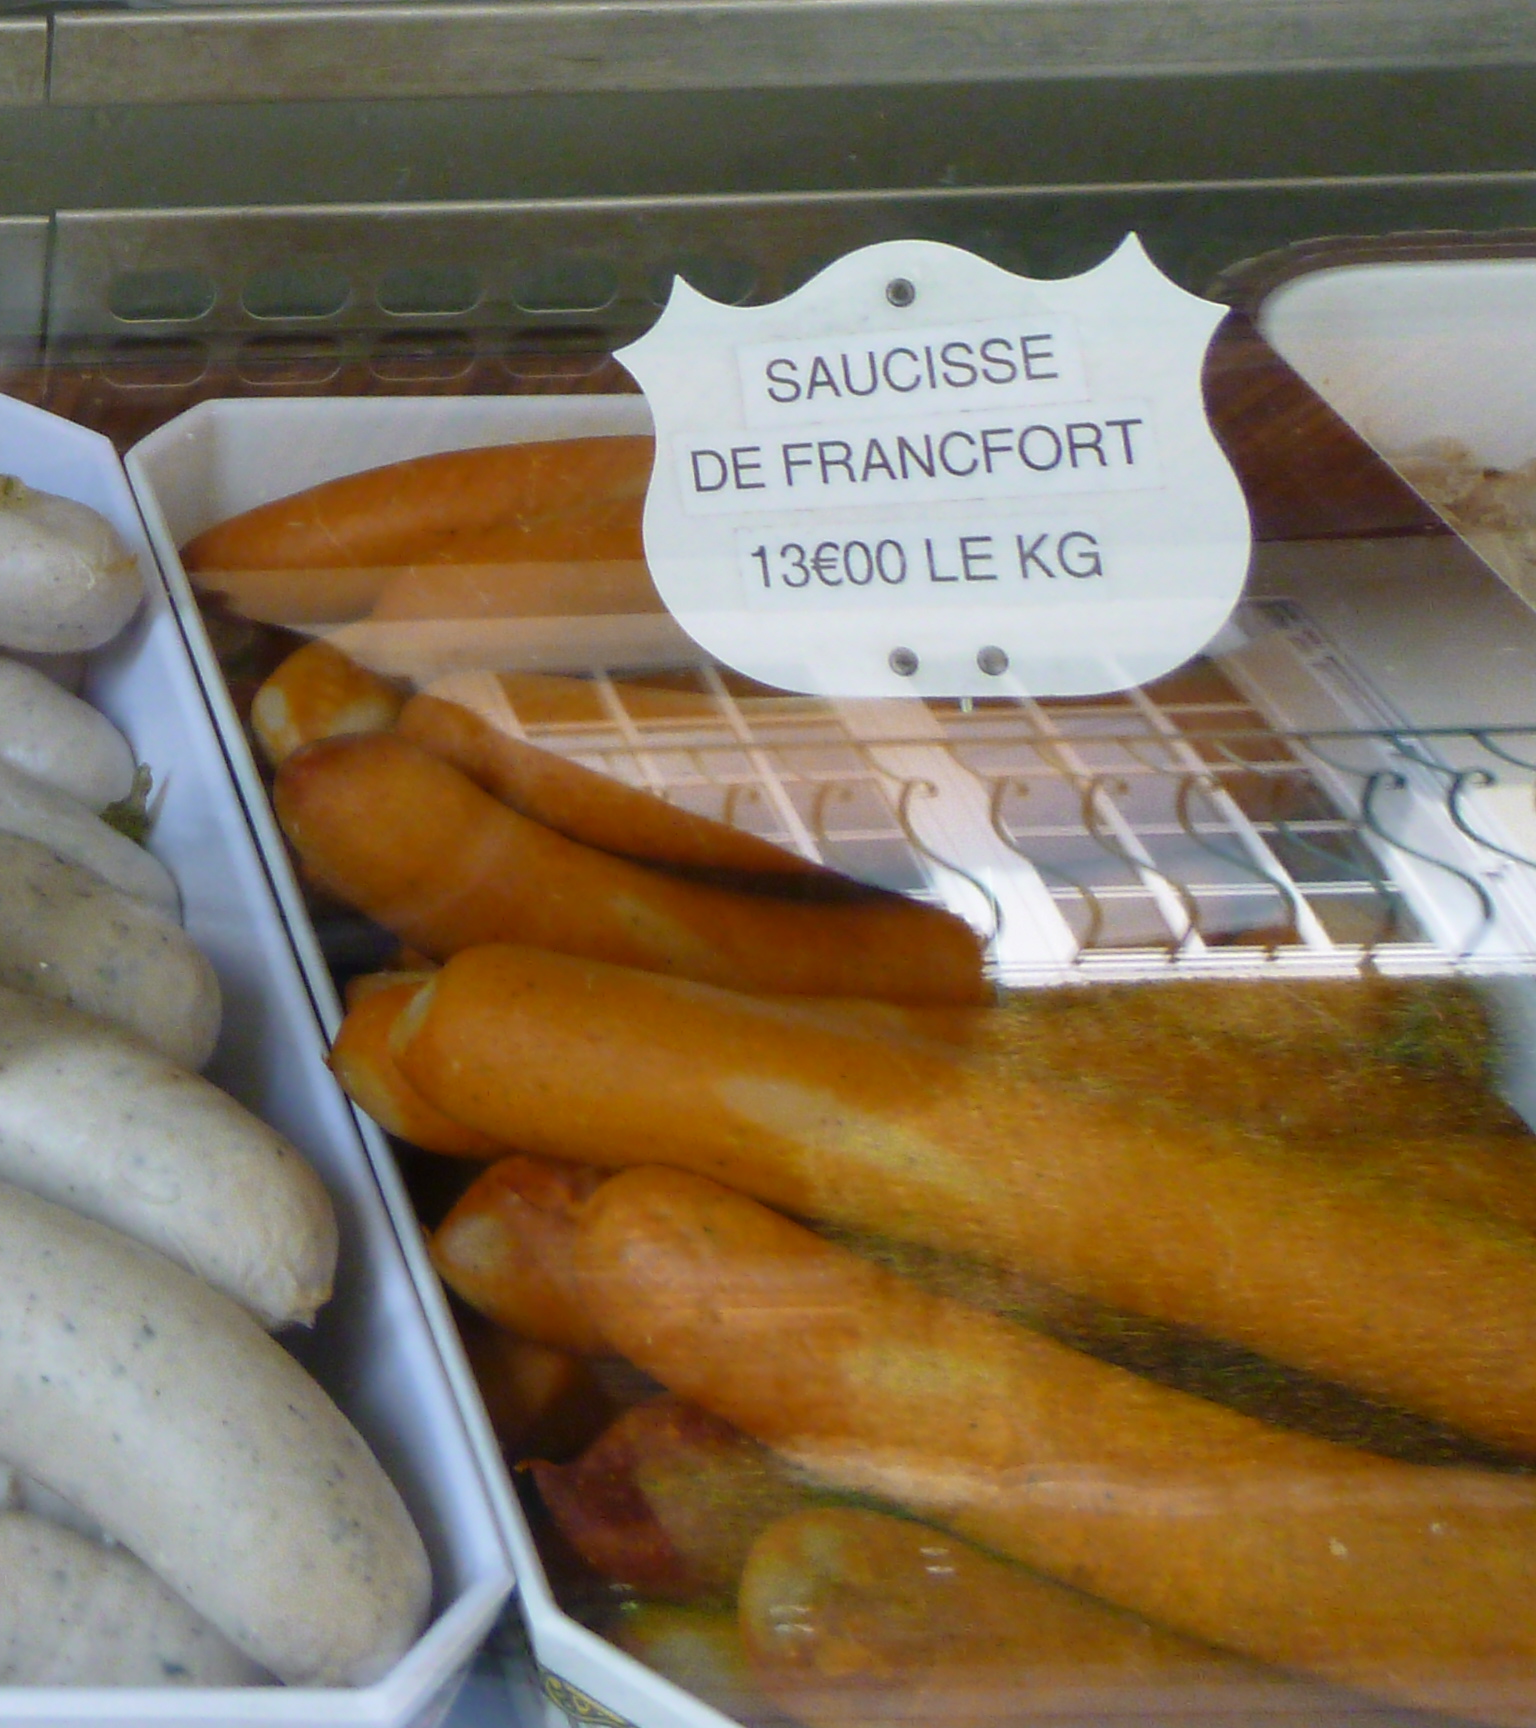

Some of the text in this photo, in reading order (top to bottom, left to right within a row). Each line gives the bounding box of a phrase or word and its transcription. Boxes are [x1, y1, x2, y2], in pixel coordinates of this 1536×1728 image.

[766, 334, 1059, 405] SAUCISSE
[691, 418, 1143, 494] DE FRANCFORT
[750, 531, 1103, 589] 13€00 LE KG
